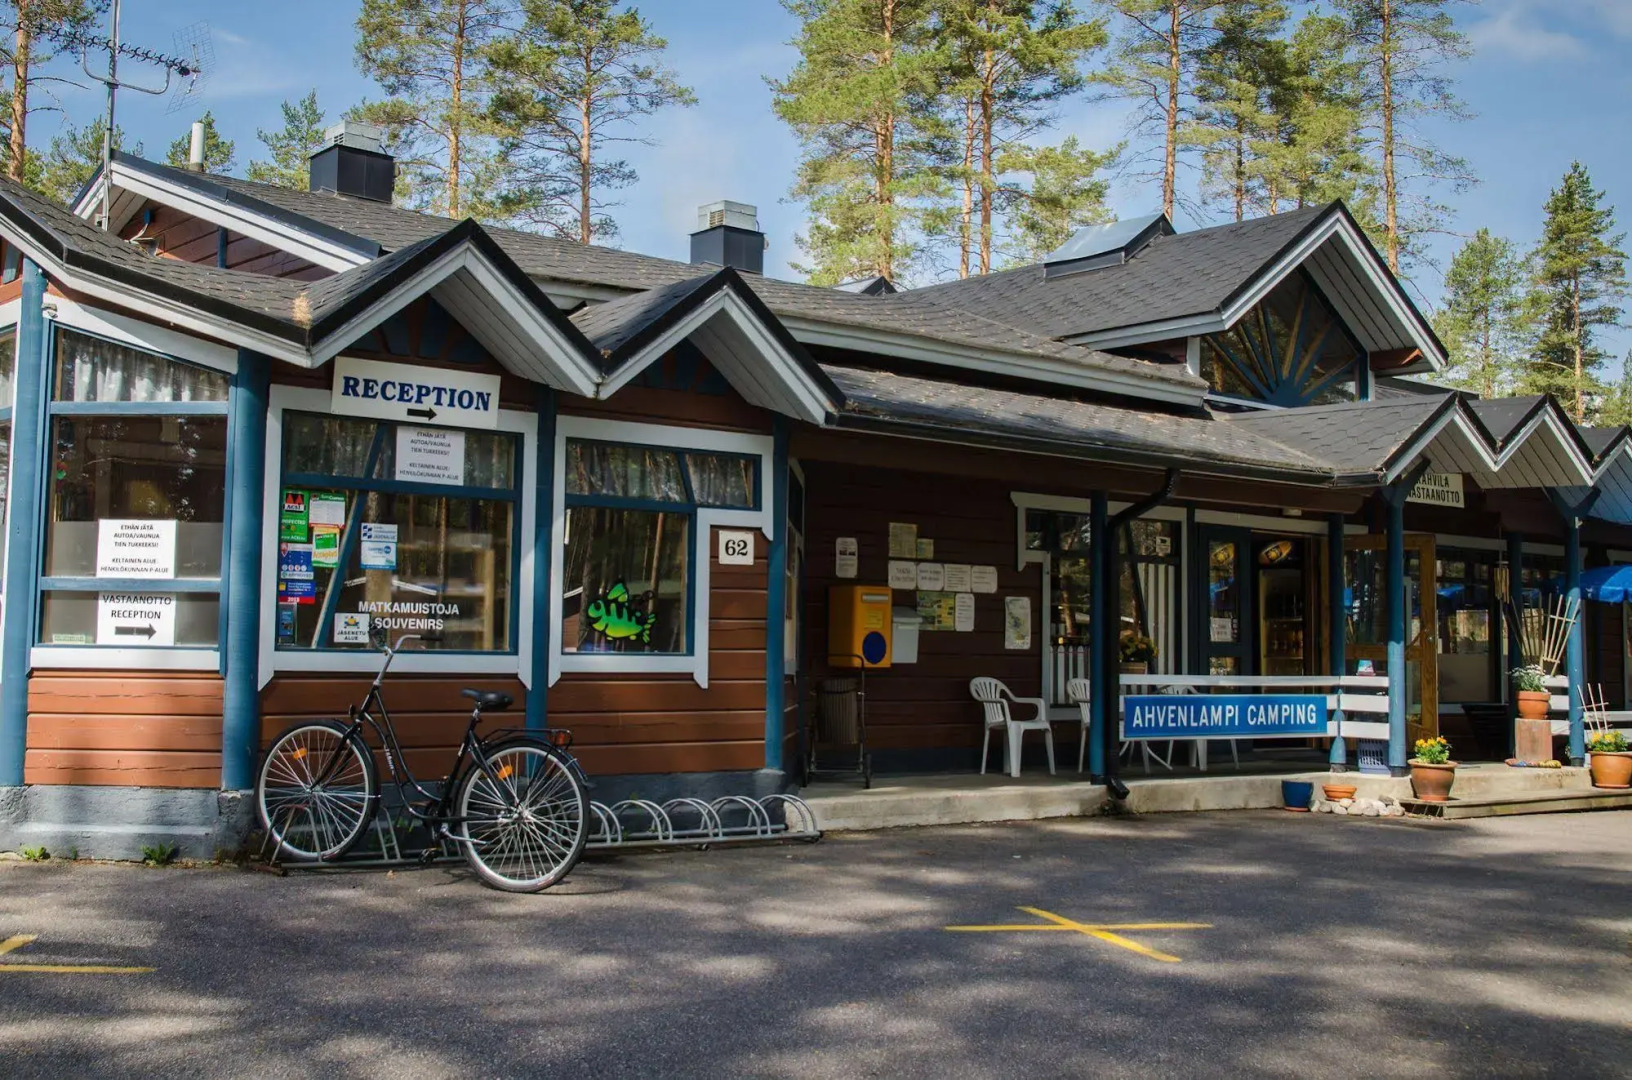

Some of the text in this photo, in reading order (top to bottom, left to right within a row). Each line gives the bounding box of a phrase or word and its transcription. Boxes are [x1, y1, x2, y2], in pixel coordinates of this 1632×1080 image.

[342, 376, 491, 411] RECEPTION
[725, 538, 749, 557] 62
[103, 595, 172, 605] VASTAANOTTO
[358, 601, 459, 614] MATKAMUISTOJA
[111, 609, 161, 620] RECEPTION
[374, 618, 444, 630] SOUVENIRS
[1132, 704, 1316, 728] AHVENLAMPI CAMPING
